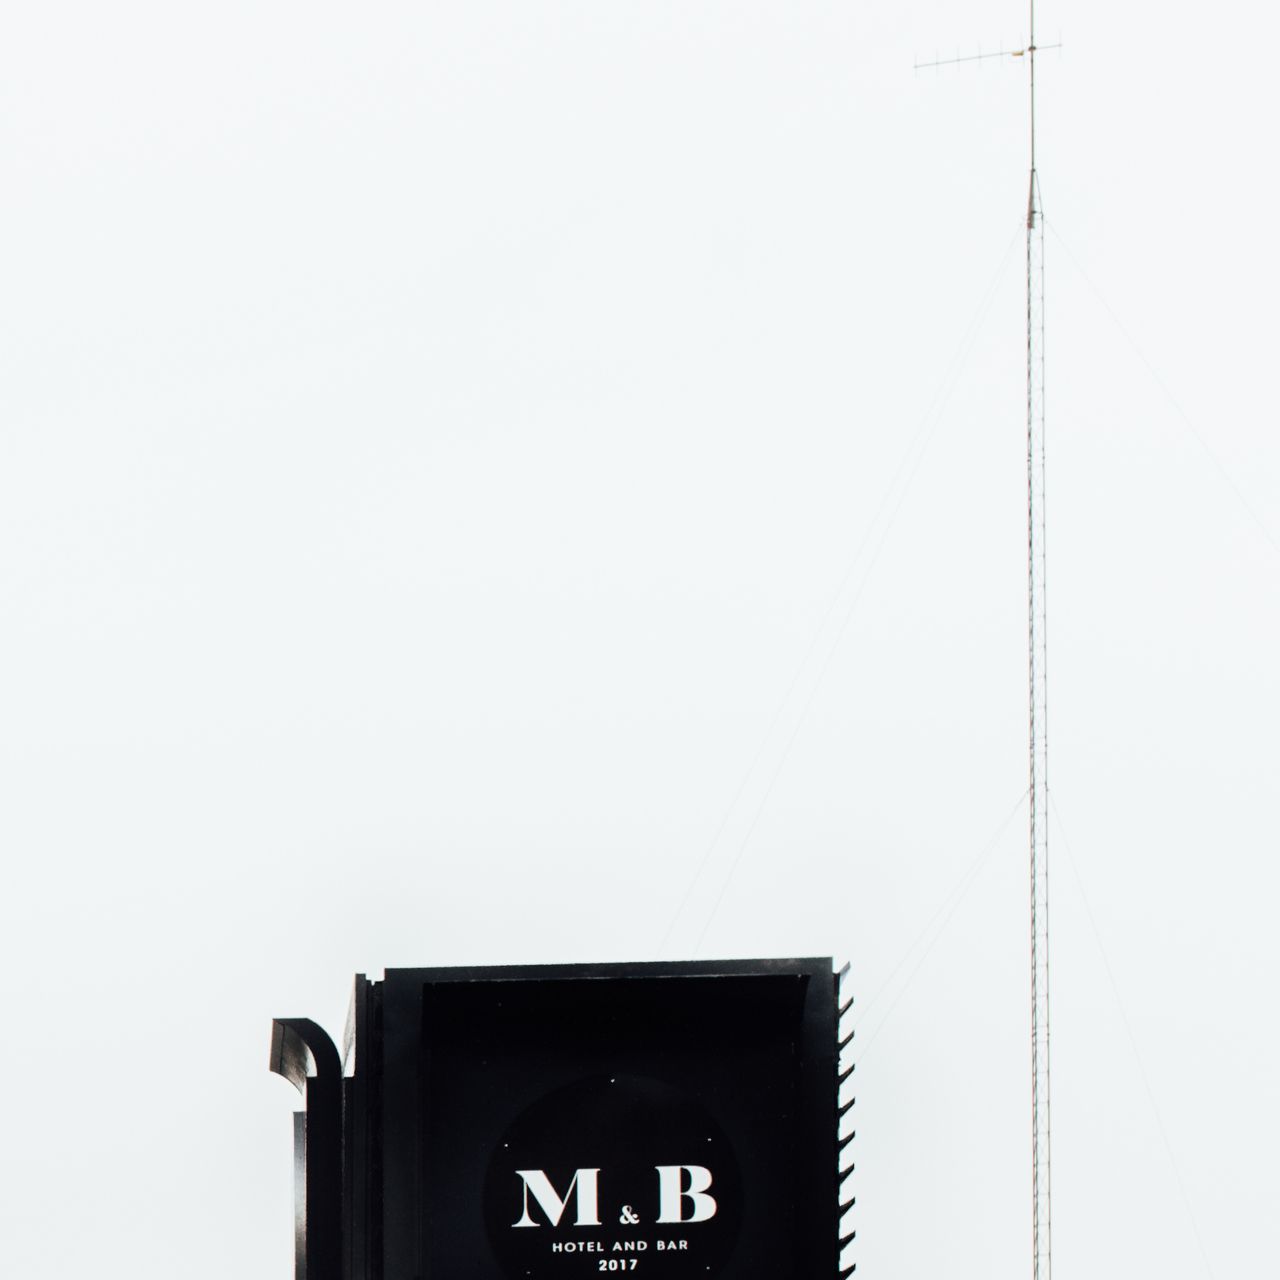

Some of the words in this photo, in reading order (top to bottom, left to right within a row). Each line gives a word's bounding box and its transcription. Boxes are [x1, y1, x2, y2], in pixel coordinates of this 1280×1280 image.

[512, 1168, 602, 1227] M
[619, 1205, 640, 1225] &
[654, 1165, 718, 1223] B
[552, 1241, 605, 1253] HOTEL
[612, 1240, 648, 1252] AND
[656, 1239, 688, 1251] BAR
[598, 1258, 638, 1272] 2017
